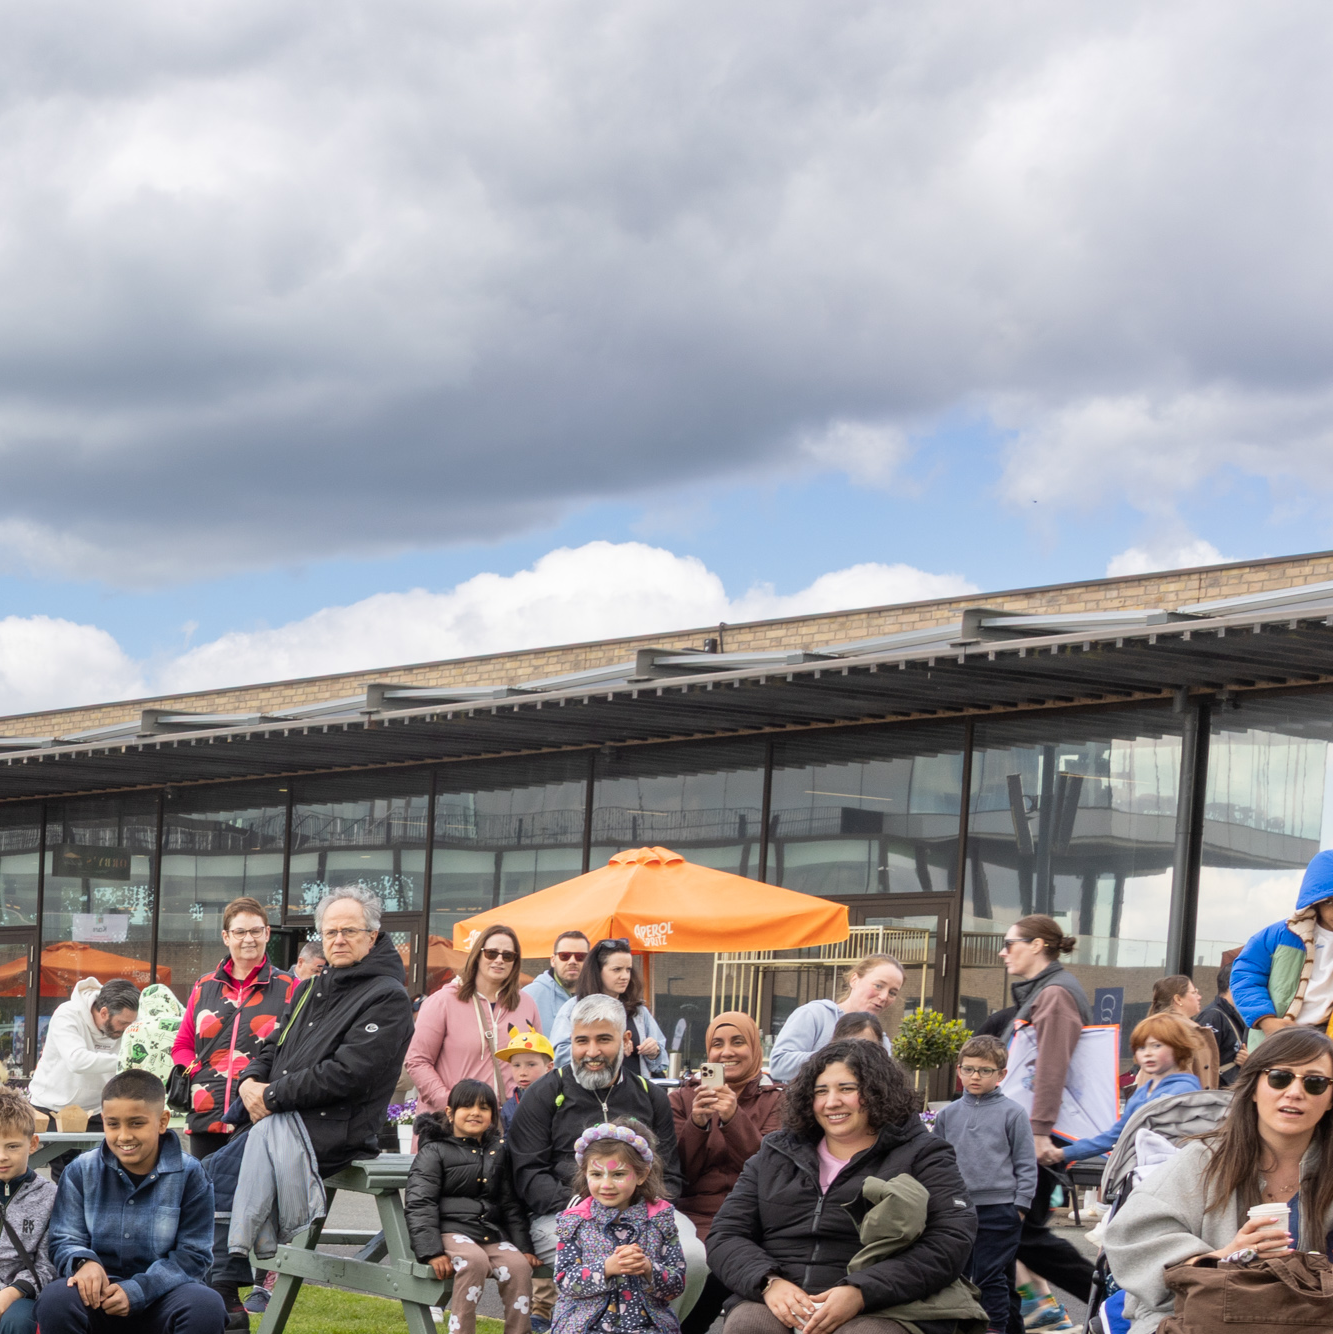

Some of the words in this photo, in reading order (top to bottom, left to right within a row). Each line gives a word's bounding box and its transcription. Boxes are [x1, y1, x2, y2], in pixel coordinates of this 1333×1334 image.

[634, 921, 674, 939] APEROL
[642, 935, 667, 947] SPRITZ
[22, 1226, 34, 1234] NY
